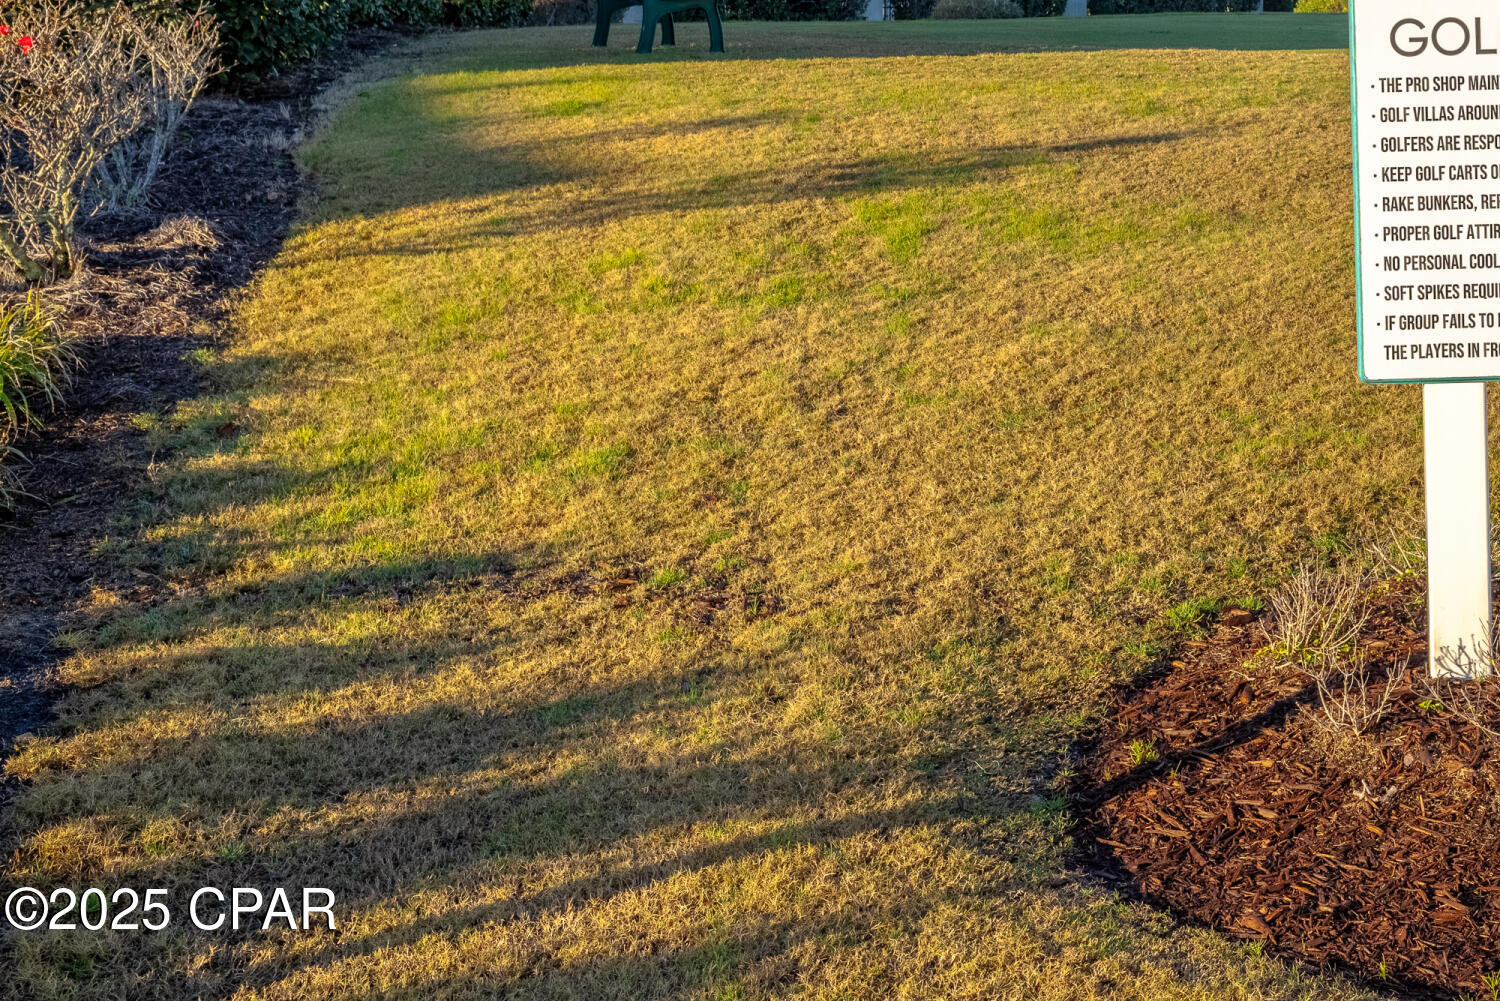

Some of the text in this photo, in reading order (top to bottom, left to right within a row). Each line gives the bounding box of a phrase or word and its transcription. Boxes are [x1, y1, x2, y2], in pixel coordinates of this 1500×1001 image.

[1379, 78, 1402, 92] THE
[1406, 77, 1429, 92] PRO
[1433, 76, 1464, 91] SHOP
[1380, 107, 1410, 122] GOLF
[1413, 106, 1454, 121] VILLAS
[1381, 136, 1433, 152] GOLFERS
[1437, 136, 1460, 151] ARE
[1382, 167, 1412, 182] KEEP
[1416, 166, 1445, 181] GOLF
[1449, 165, 1487, 180] CARTS
[1383, 196, 1414, 211] RAKE
[1418, 195, 1477, 211] BUNKERS,
[1383, 226, 1430, 241] PROPER
[1434, 225, 1463, 240] GOLF
[1384, 256, 1400, 271] NO
[1404, 254, 1466, 270] PERSONAL
[1385, 285, 1414, 301] SOFT
[1418, 284, 1459, 300] SPIKES
[1385, 316, 1395, 330] IF
[1399, 315, 1439, 330] GROUP
[1443, 313, 1475, 328] FAILS
[1479, 313, 1494, 328] TO
[1384, 345, 1407, 360] THE
[1411, 343, 1464, 359] PLAYERS
[1468, 343, 1479, 358] IN
